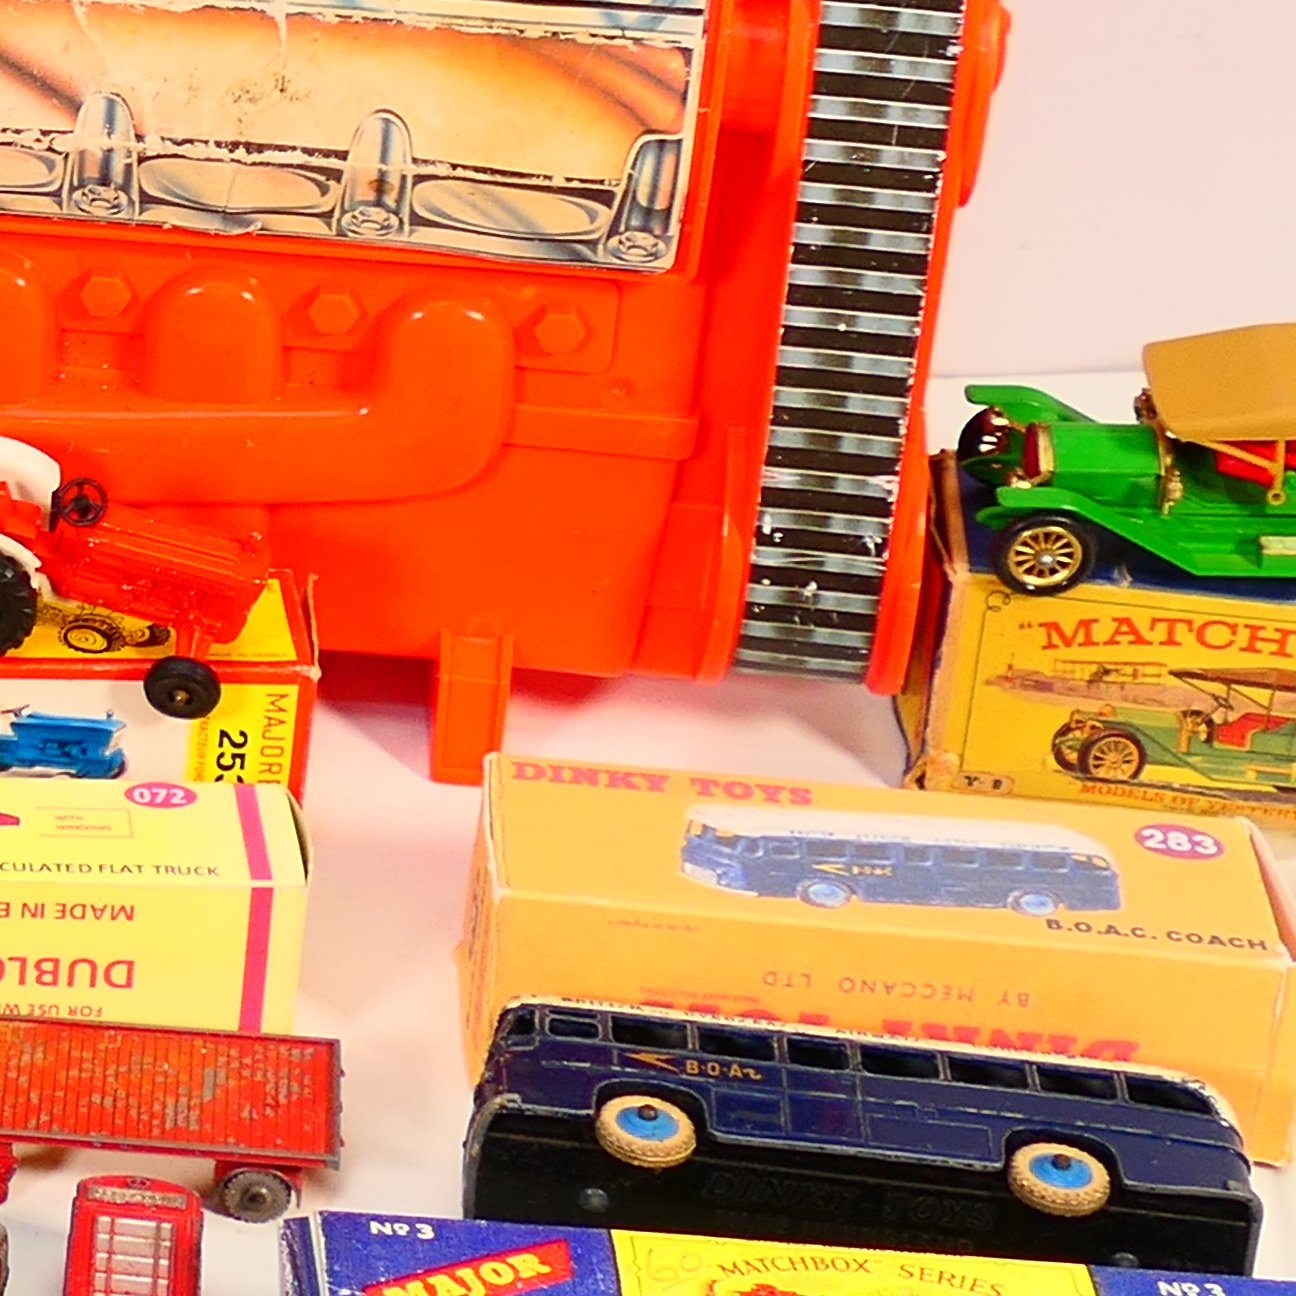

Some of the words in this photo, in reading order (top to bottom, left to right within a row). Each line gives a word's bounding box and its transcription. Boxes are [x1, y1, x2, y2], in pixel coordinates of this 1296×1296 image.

[511, 760, 670, 793] DINKY
[689, 776, 813, 806] TOYS
[1080, 782, 1165, 804] MODELS
[132, 787, 188, 805] 072
[1140, 828, 1218, 855] 283
[98, 863, 145, 876] FLAT
[152, 864, 221, 878] TRUCK
[21, 902, 46, 920] IN
[54, 902, 136, 922] MADE
[1166, 929, 1268, 952] COACH
[762, 970, 813, 990] LTD
[838, 976, 976, 1004] MECCANO
[996, 990, 1031, 1007] BY
[26, 1003, 60, 1018] USE
[67, 1004, 103, 1019] FOR
[897, 1262, 1008, 1296] SERIES
